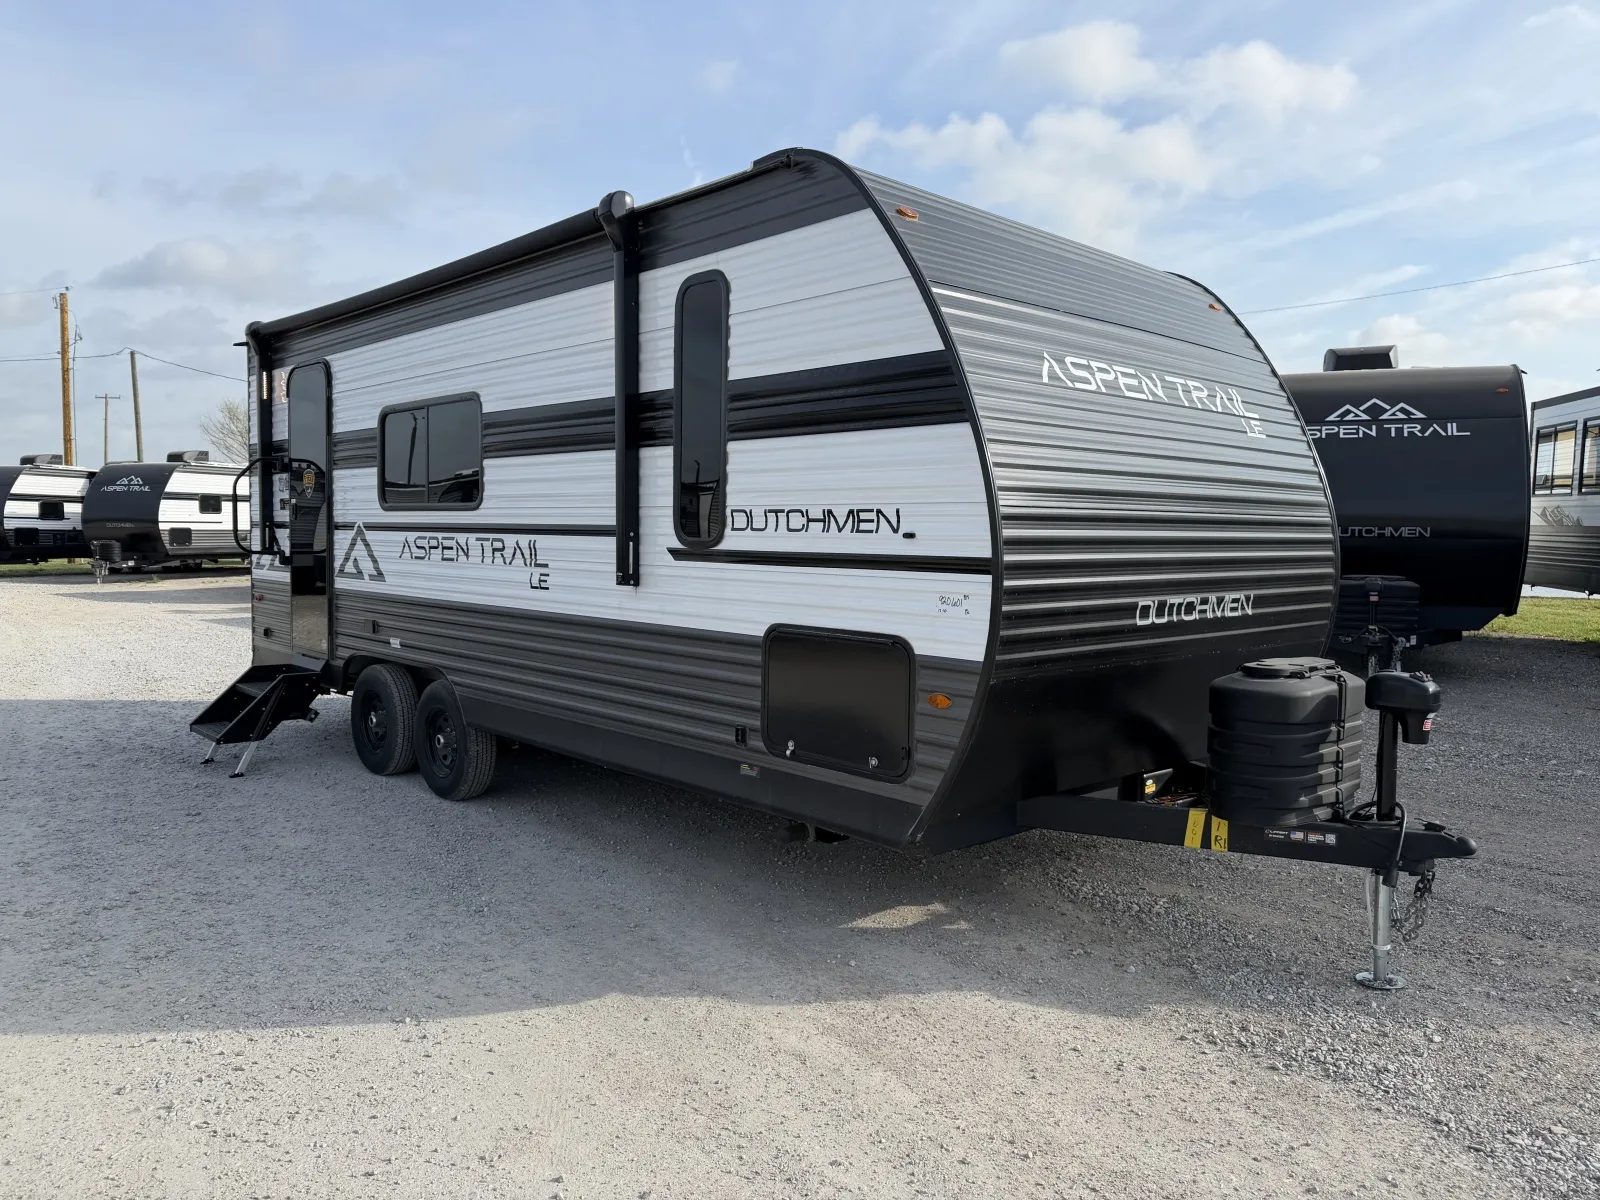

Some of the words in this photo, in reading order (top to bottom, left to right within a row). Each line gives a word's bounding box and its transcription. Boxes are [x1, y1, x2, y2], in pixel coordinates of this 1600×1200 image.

[1042, 351, 1168, 402] ASPEN
[1165, 376, 1259, 419] TRAIL
[1240, 418, 1266, 439] LE
[1306, 425, 1377, 439] SPEN
[1383, 422, 1471, 437] TRAIL
[731, 508, 901, 534] DUTCHMEN
[1338, 526, 1431, 538] UTCHMEN
[399, 535, 470, 561] ASPEN
[475, 537, 549, 568] TRAIL
[529, 572, 550, 590] LE
[1136, 594, 1254, 625] DUTCHMEN
